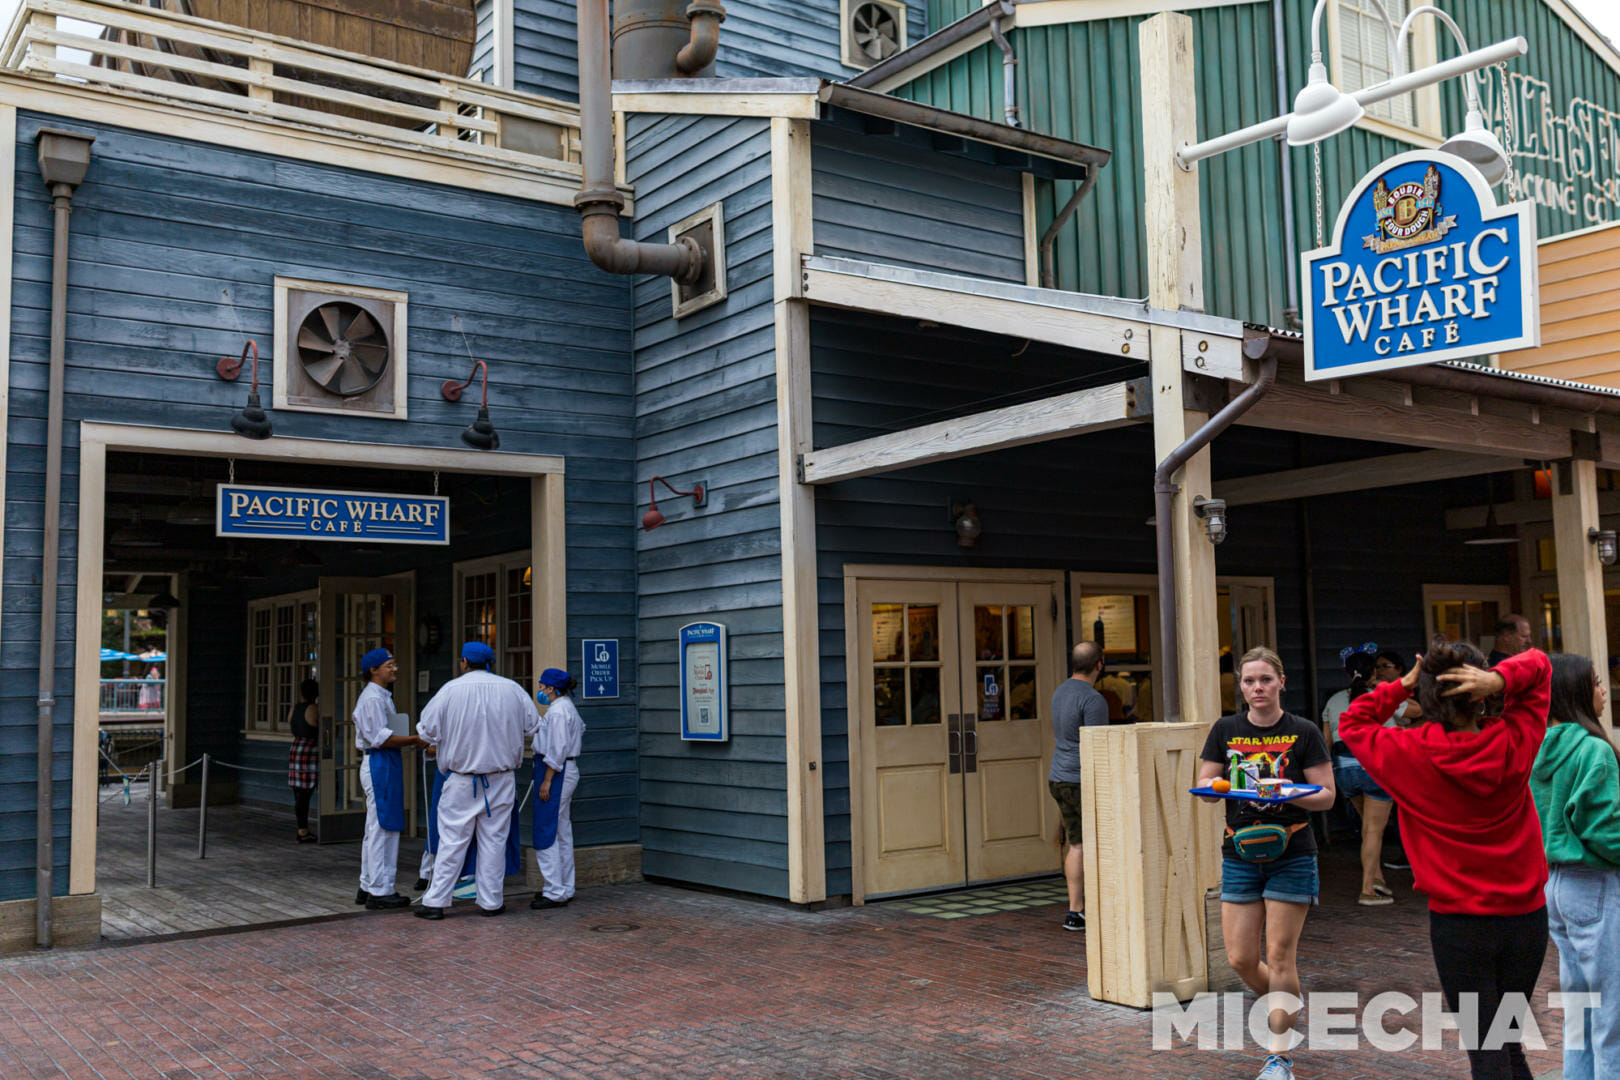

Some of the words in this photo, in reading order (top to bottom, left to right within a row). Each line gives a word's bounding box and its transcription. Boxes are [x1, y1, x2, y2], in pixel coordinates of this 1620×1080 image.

[1388, 185, 1424, 204] BOUDIN
[1319, 227, 1509, 307] PACIFIC
[1332, 275, 1499, 345] WHARF
[1374, 321, 1460, 356] CAFÉ
[228, 492, 338, 519] PACIFIC
[345, 499, 440, 527] WHARF
[310, 519, 362, 534] CAFÉ
[1227, 736, 1262, 746] STAR
[1262, 735, 1298, 745] WARS
